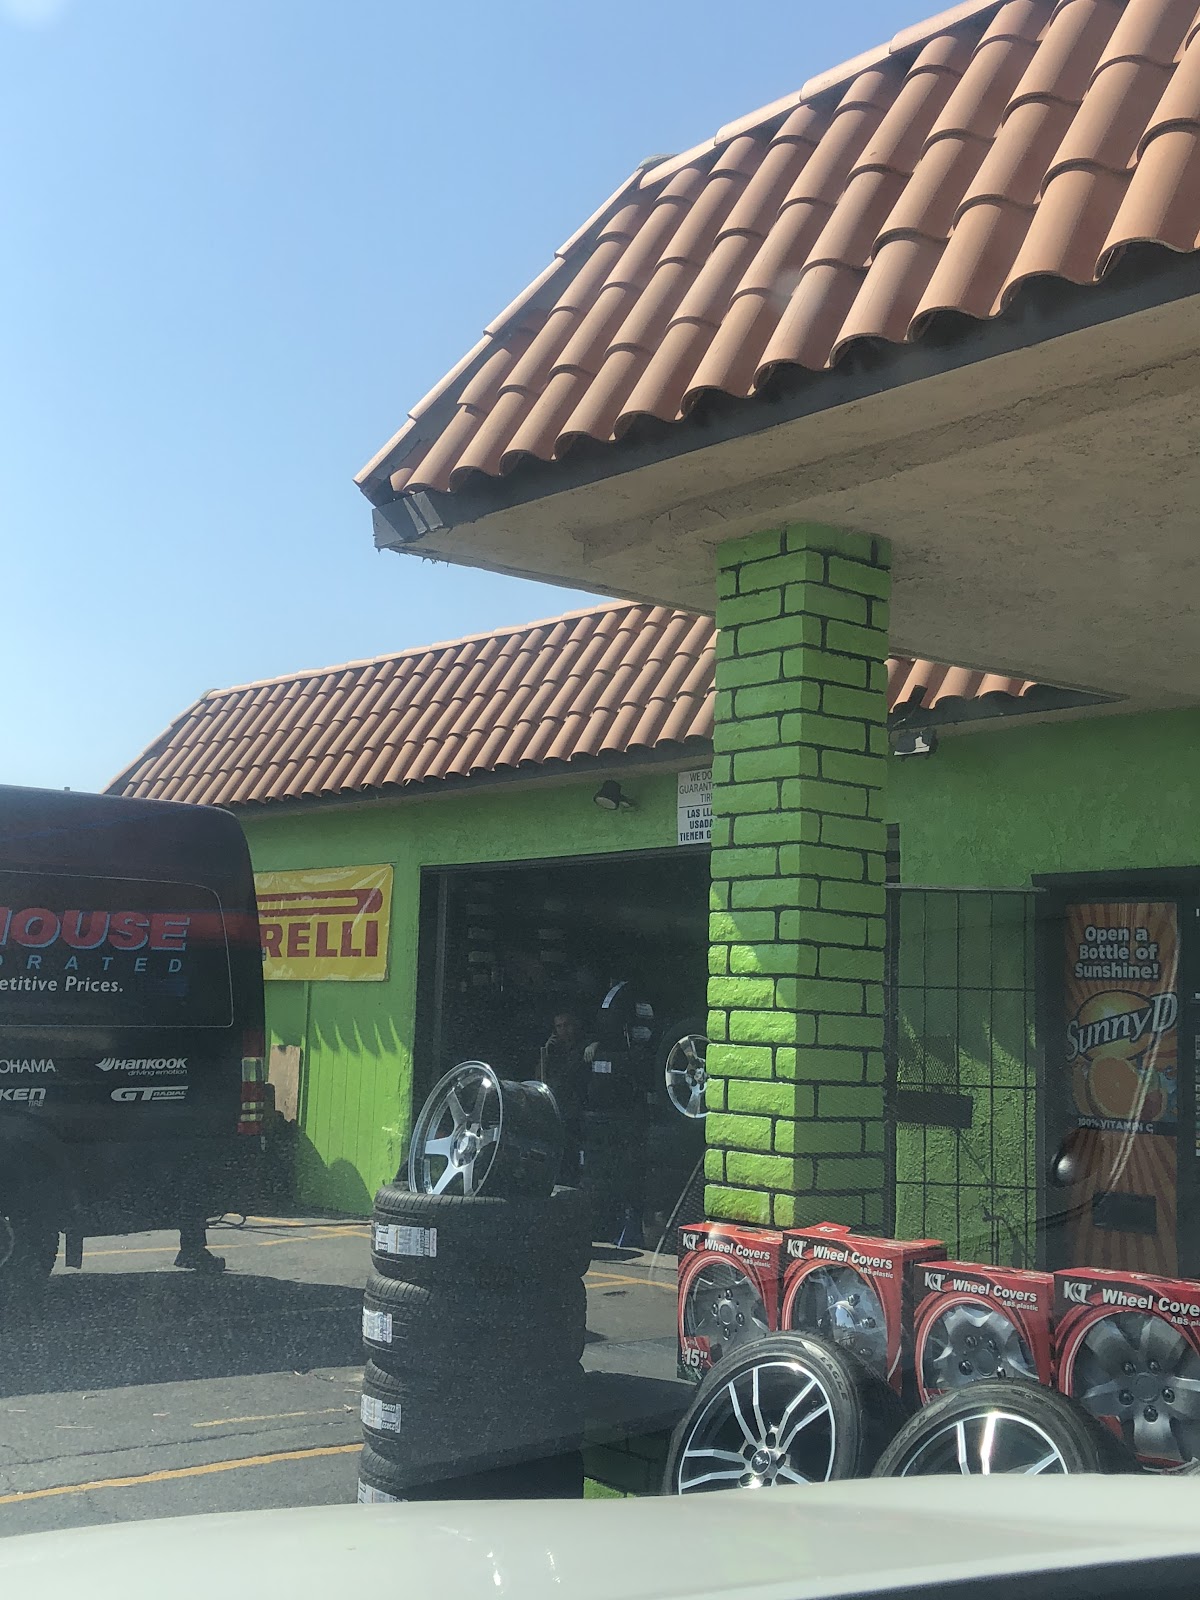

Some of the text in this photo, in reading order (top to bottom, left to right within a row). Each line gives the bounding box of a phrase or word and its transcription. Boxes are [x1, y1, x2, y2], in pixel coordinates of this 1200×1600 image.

[690, 772, 700, 782] WE
[688, 809, 700, 818] LAS
[0, 906, 190, 951] OUSE
[1085, 926, 1148, 942] Open a
[1080, 944, 1158, 961] Bottle of
[1075, 962, 1159, 979] Sunshine!
[65, 976, 124, 992] Prices.
[704, 1238, 770, 1260] Wheel Covers
[813, 1245, 893, 1270] Wheel Covers
[859, 1267, 894, 1279] ABS plastic
[953, 1279, 1037, 1302] Wheel Covers
[1017, 1303, 1038, 1312] plastic
[1102, 1288, 1200, 1317] Wheel Cove
[1171, 1316, 1188, 1326] ABS
